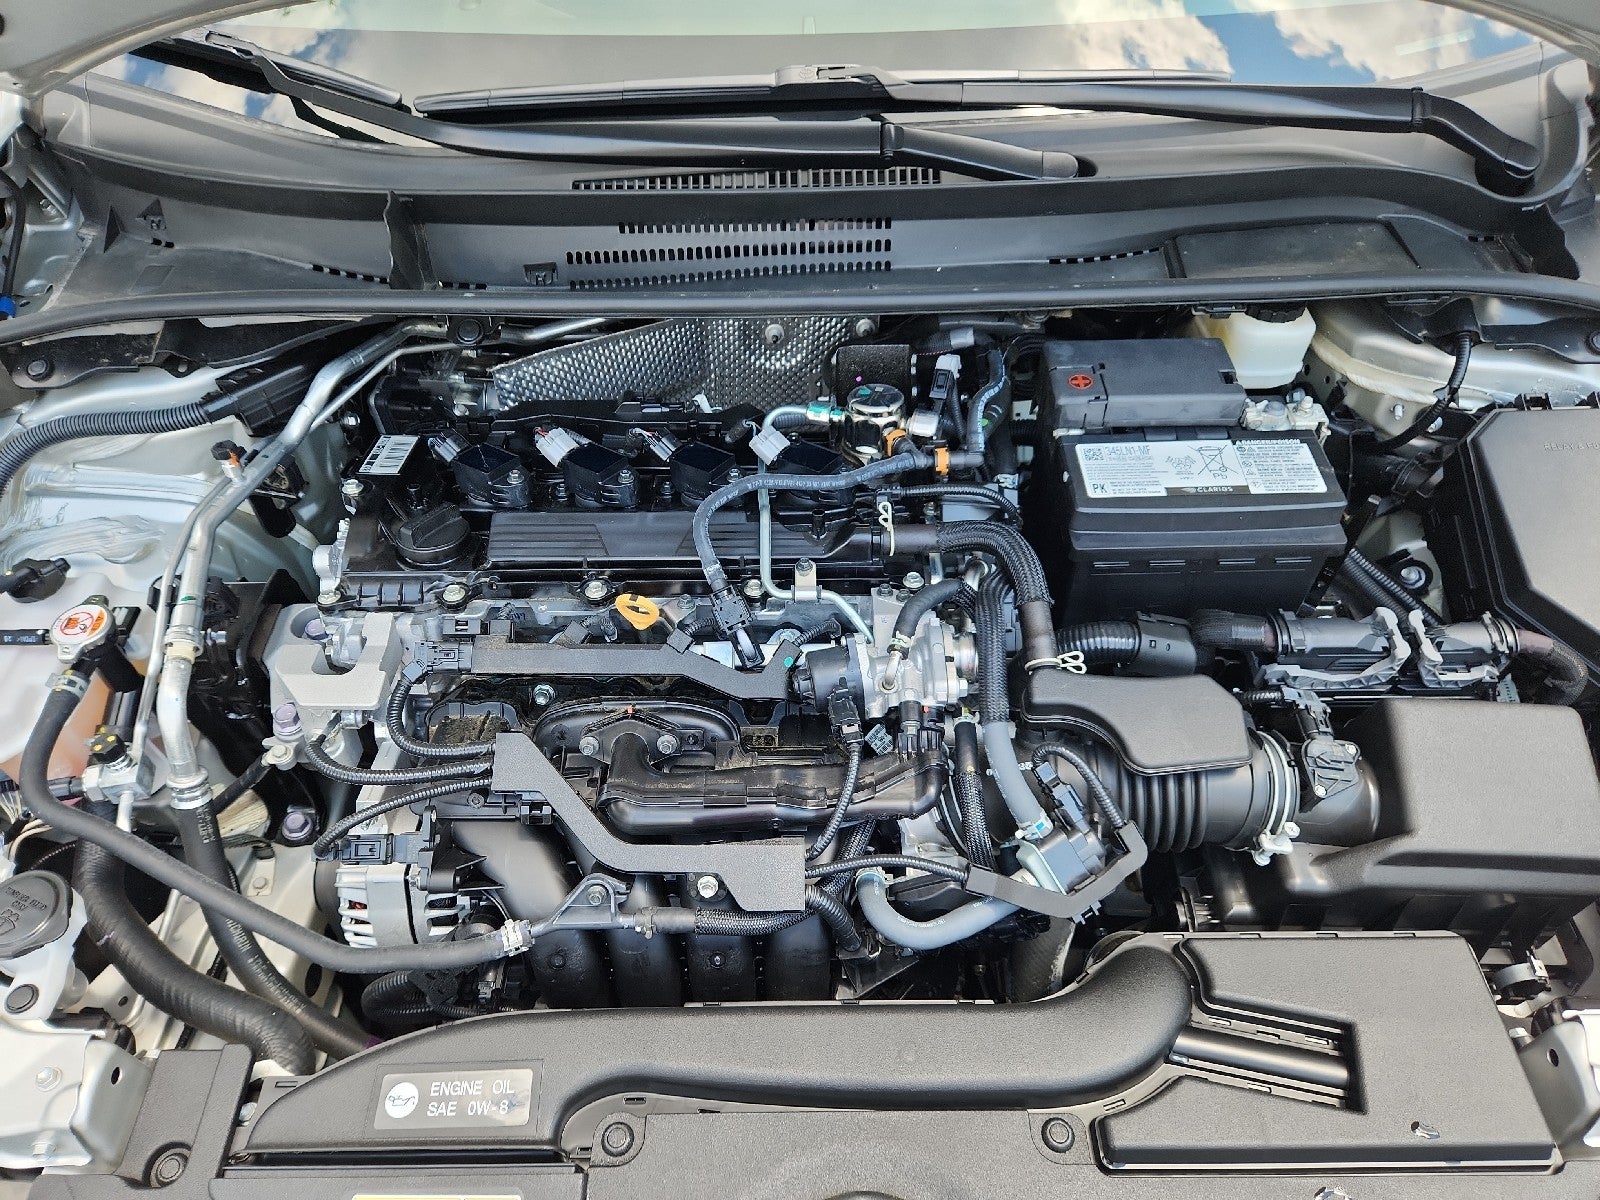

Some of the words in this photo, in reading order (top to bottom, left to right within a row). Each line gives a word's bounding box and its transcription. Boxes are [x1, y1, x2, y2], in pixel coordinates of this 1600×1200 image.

[1091, 483, 1108, 494] PK
[1196, 486, 1235, 494] CLARIOS
[429, 1079, 484, 1097] ENGINE
[491, 1077, 516, 1095] OIL
[426, 1100, 458, 1117] SAE
[467, 1099, 510, 1117] 0W-8
